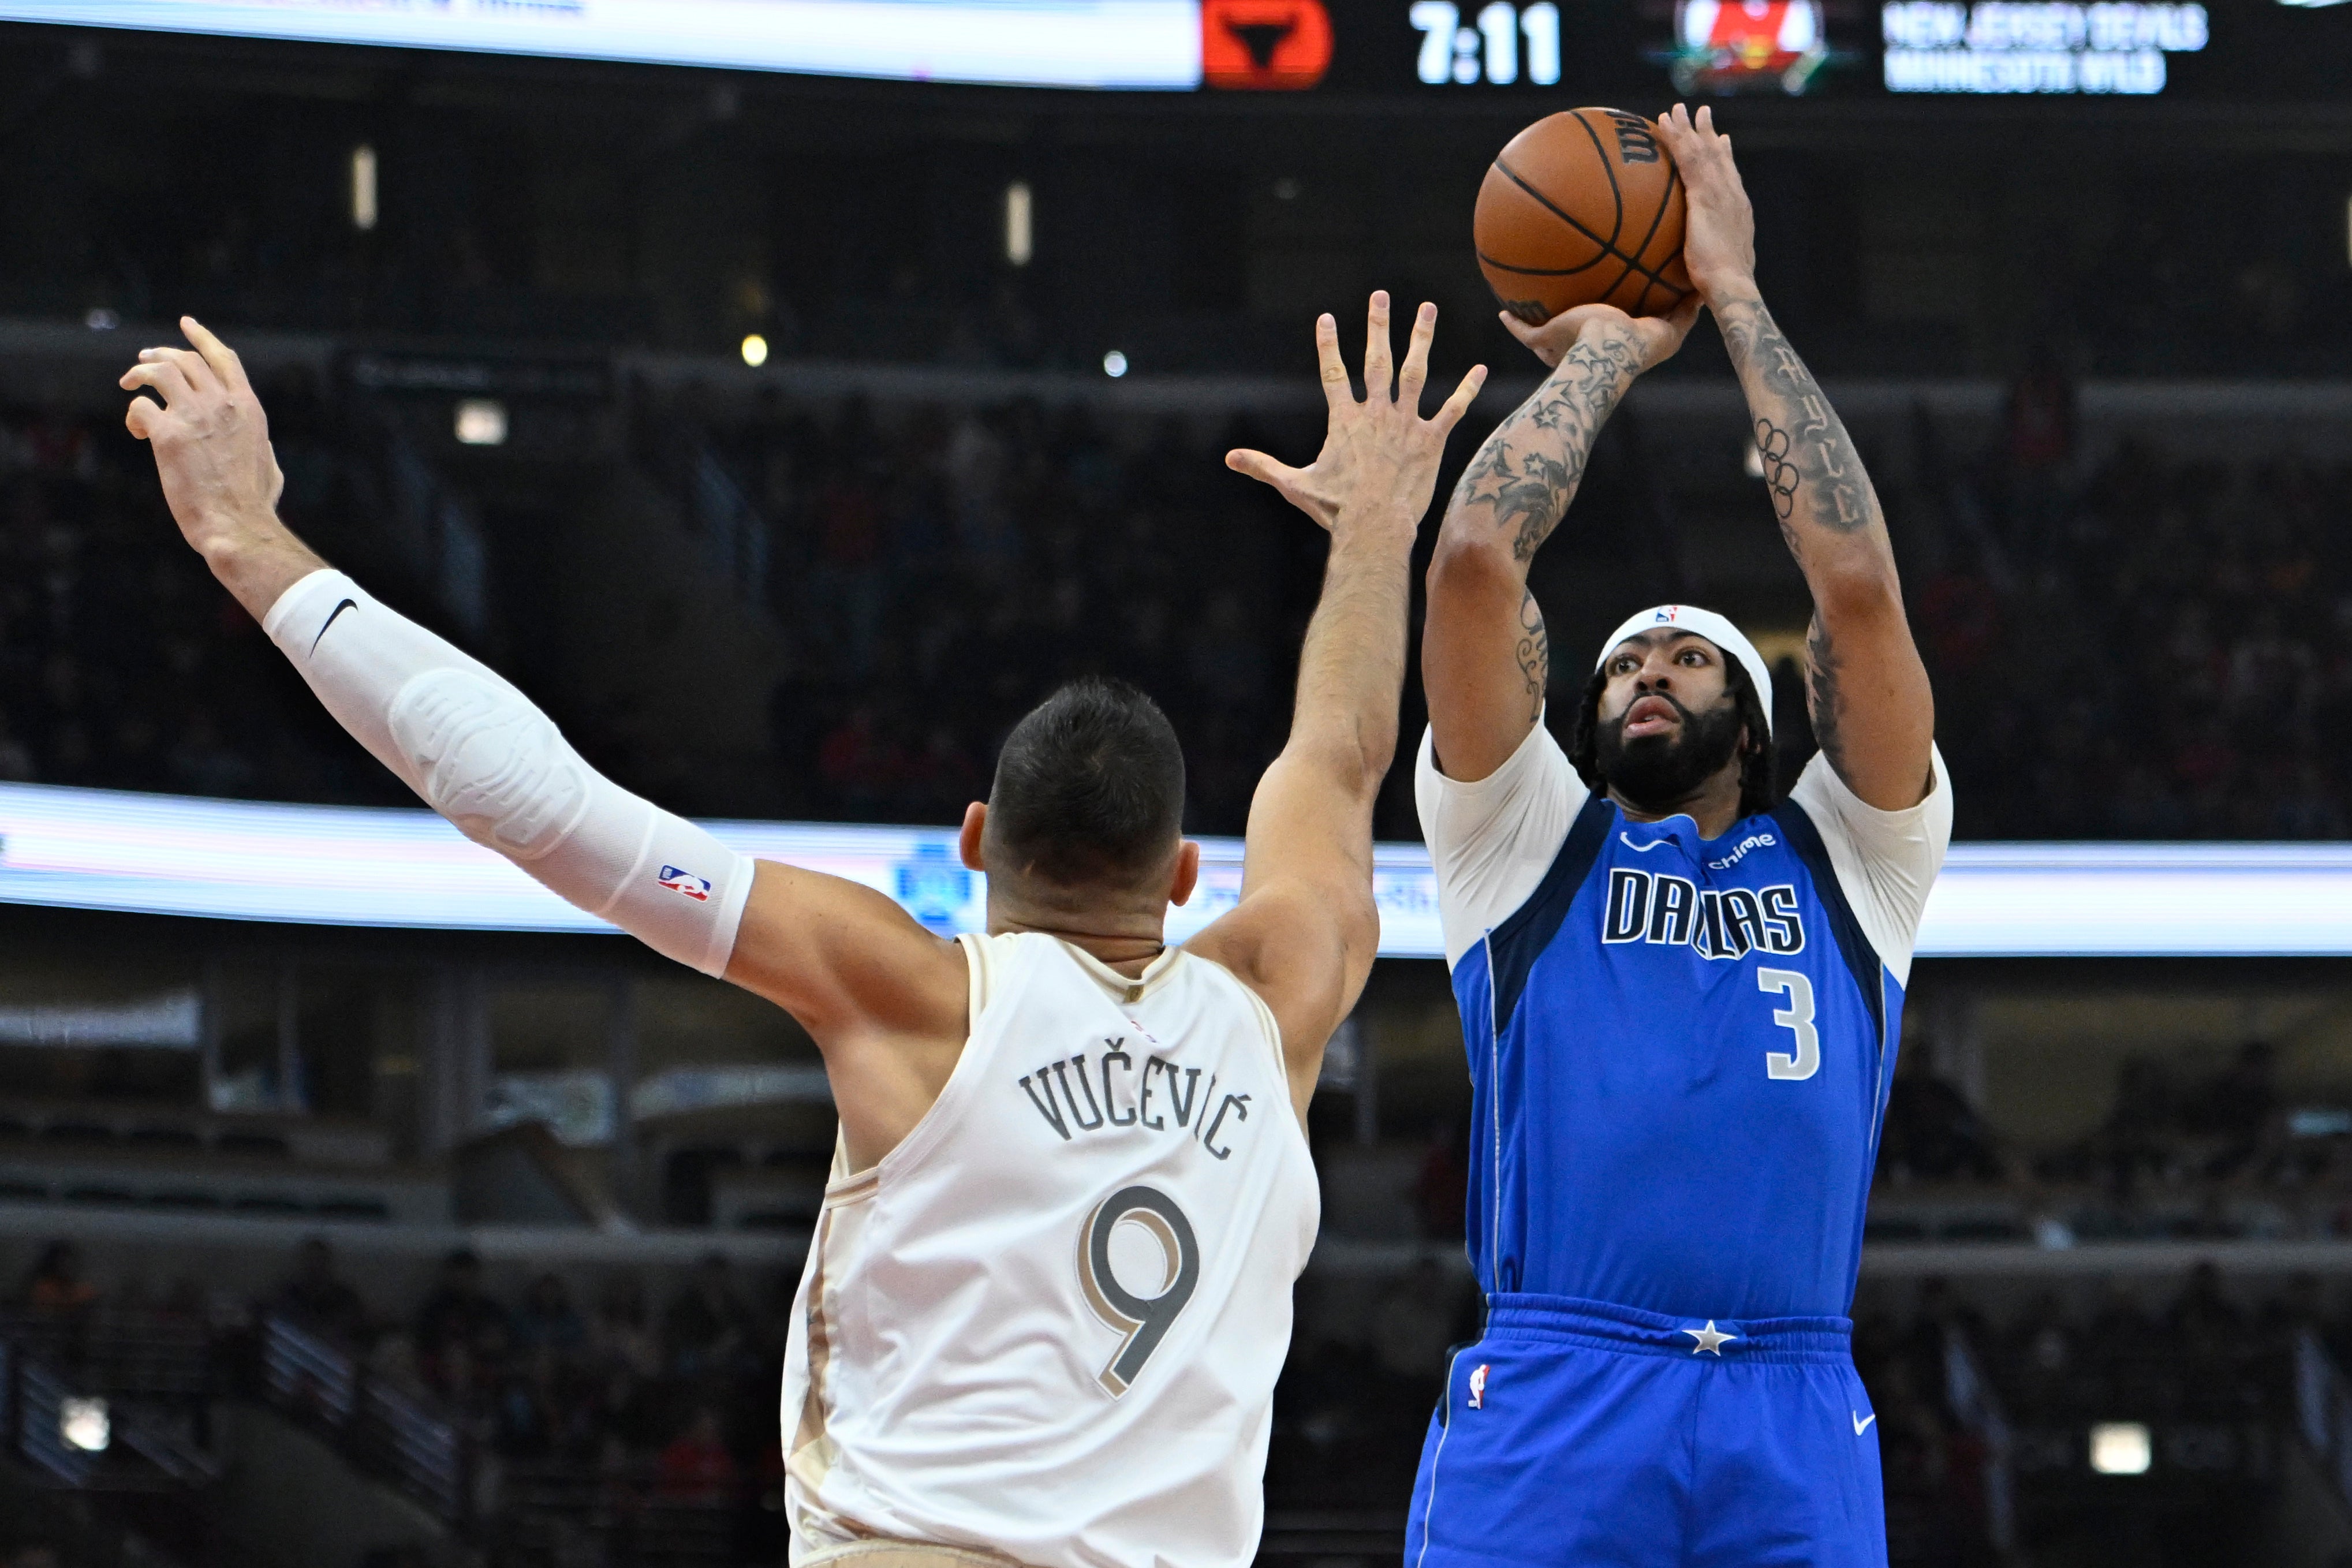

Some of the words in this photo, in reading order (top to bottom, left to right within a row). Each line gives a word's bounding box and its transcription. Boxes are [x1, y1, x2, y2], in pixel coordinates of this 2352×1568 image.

[1410, 1, 1560, 84] 7:11
[1708, 834, 1776, 869] chime
[1757, 967, 1820, 1080] 3
[1076, 1185, 1200, 1402] 9
